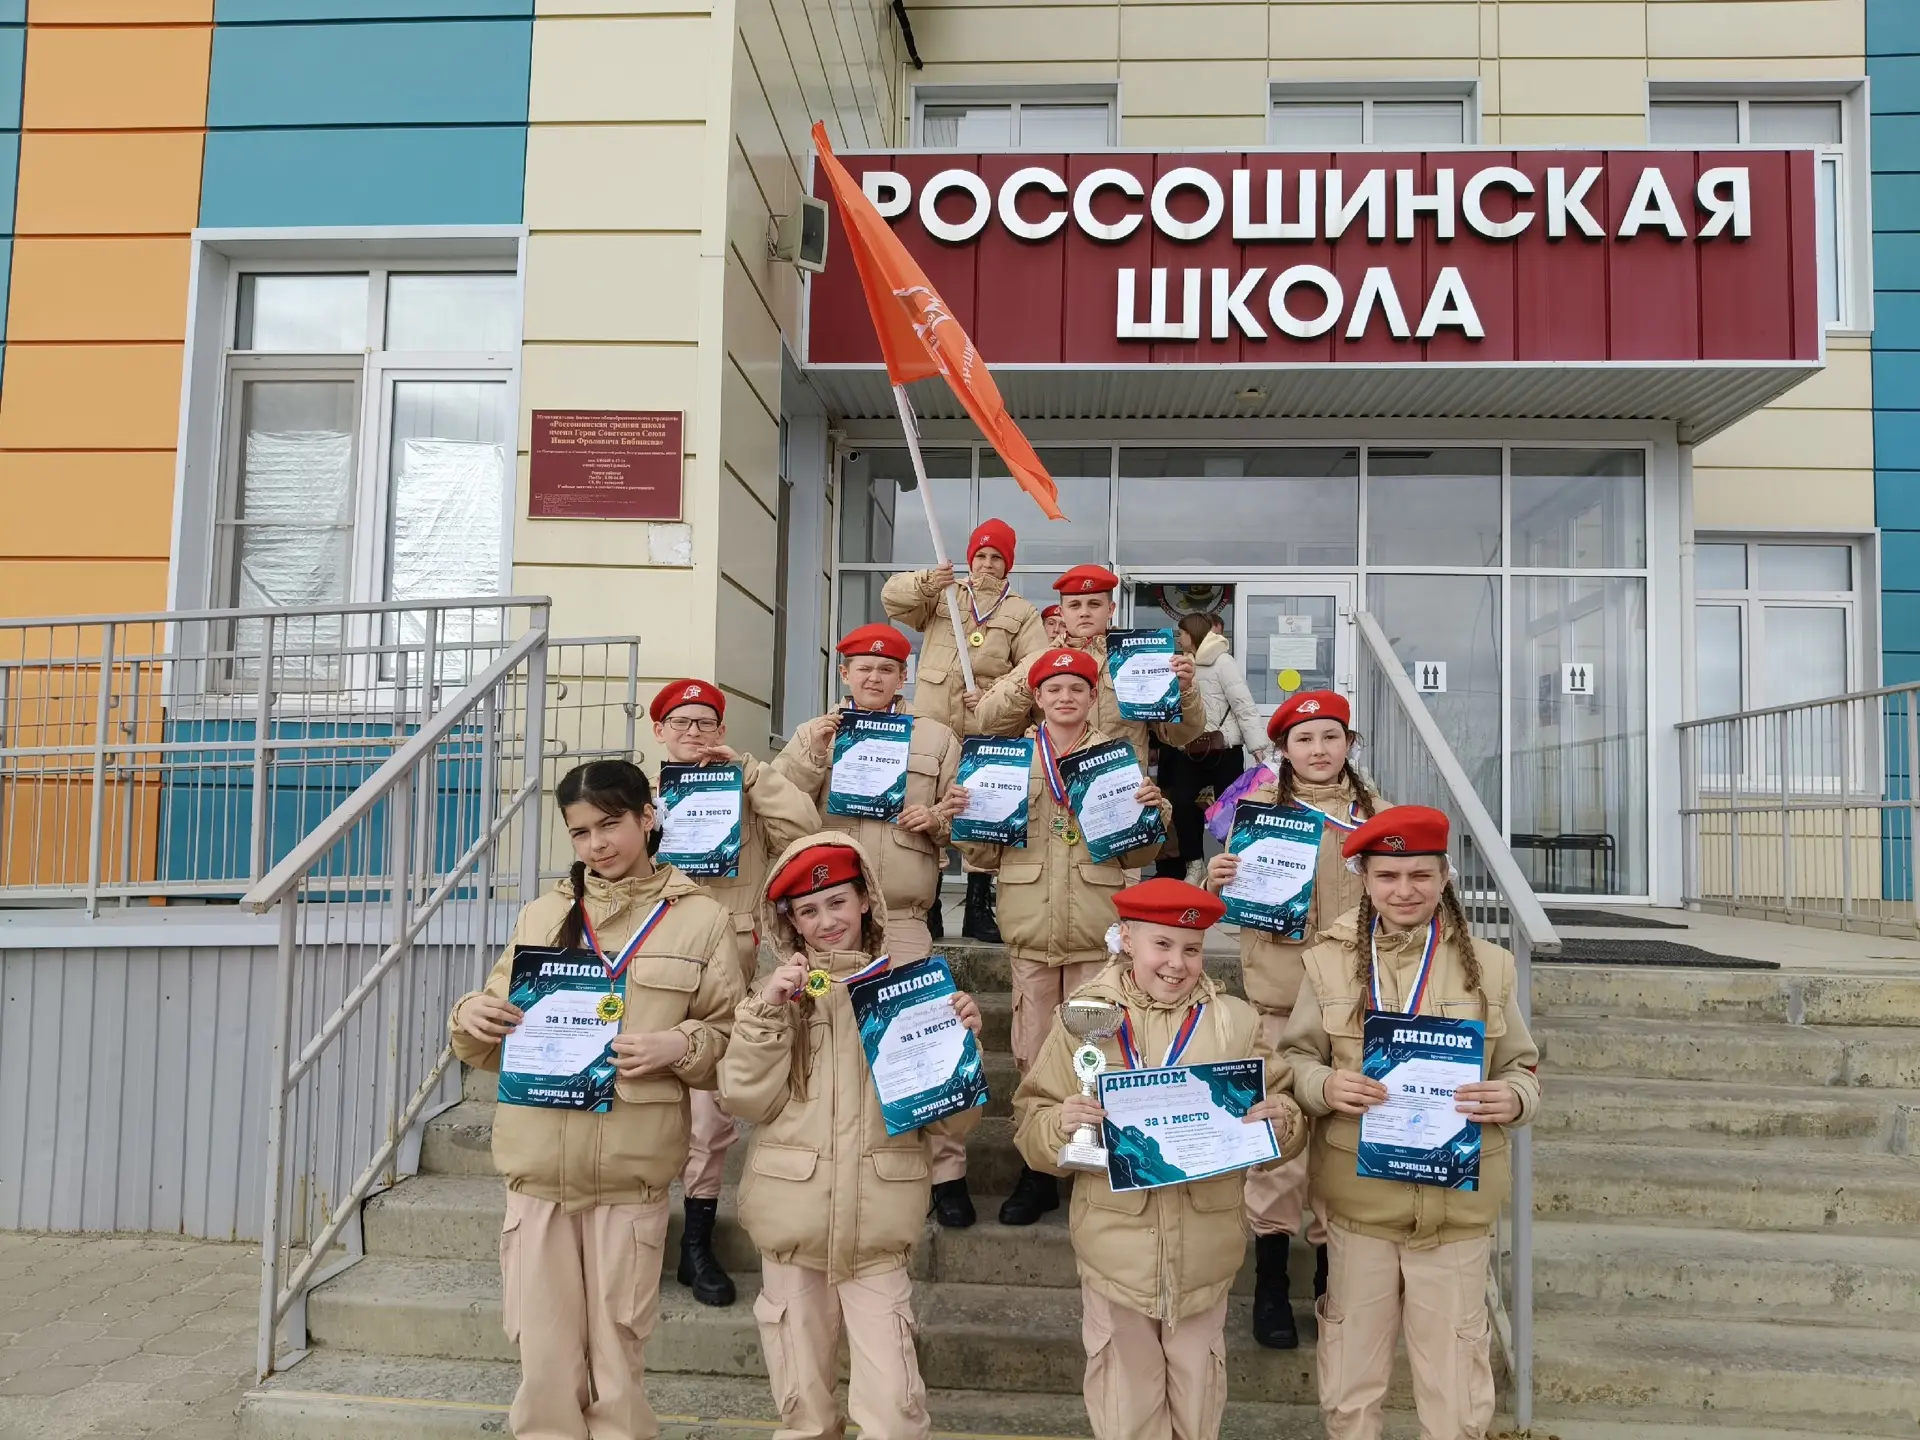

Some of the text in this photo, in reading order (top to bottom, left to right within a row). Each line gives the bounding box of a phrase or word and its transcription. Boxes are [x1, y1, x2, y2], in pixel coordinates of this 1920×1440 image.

[862, 167, 1751, 241] РОССОШИНСКАЯ
[1117, 265, 1485, 339] ШКОЛА
[1122, 637, 1167, 648] ДИПЛОМ
[855, 720, 906, 733] ДИПЛОМ
[977, 745, 1026, 757] ДИПЛОМ
[1078, 747, 1129, 773] ДИПЛОМ
[680, 771, 735, 784] ДИПЛОМ
[1254, 813, 1315, 833] ДИПЛОМ
[1256, 855, 1307, 870] за 1 место
[877, 969, 946, 1003] ДИПЛОМ
[545, 1015, 559, 1024] за
[563, 1016, 568, 1024] 1
[900, 1017, 957, 1044] за 1 место
[1392, 1029, 1473, 1049] ДИПЛОМ
[1105, 1071, 1187, 1093] ДИПЛОМ
[527, 1088, 570, 1099] ЗАРНИЦА
[1402, 1084, 1458, 1098] за 1 мес
[1144, 1111, 1210, 1127] за 1 место
[1388, 1160, 1432, 1173] ЗАРНИЦА
